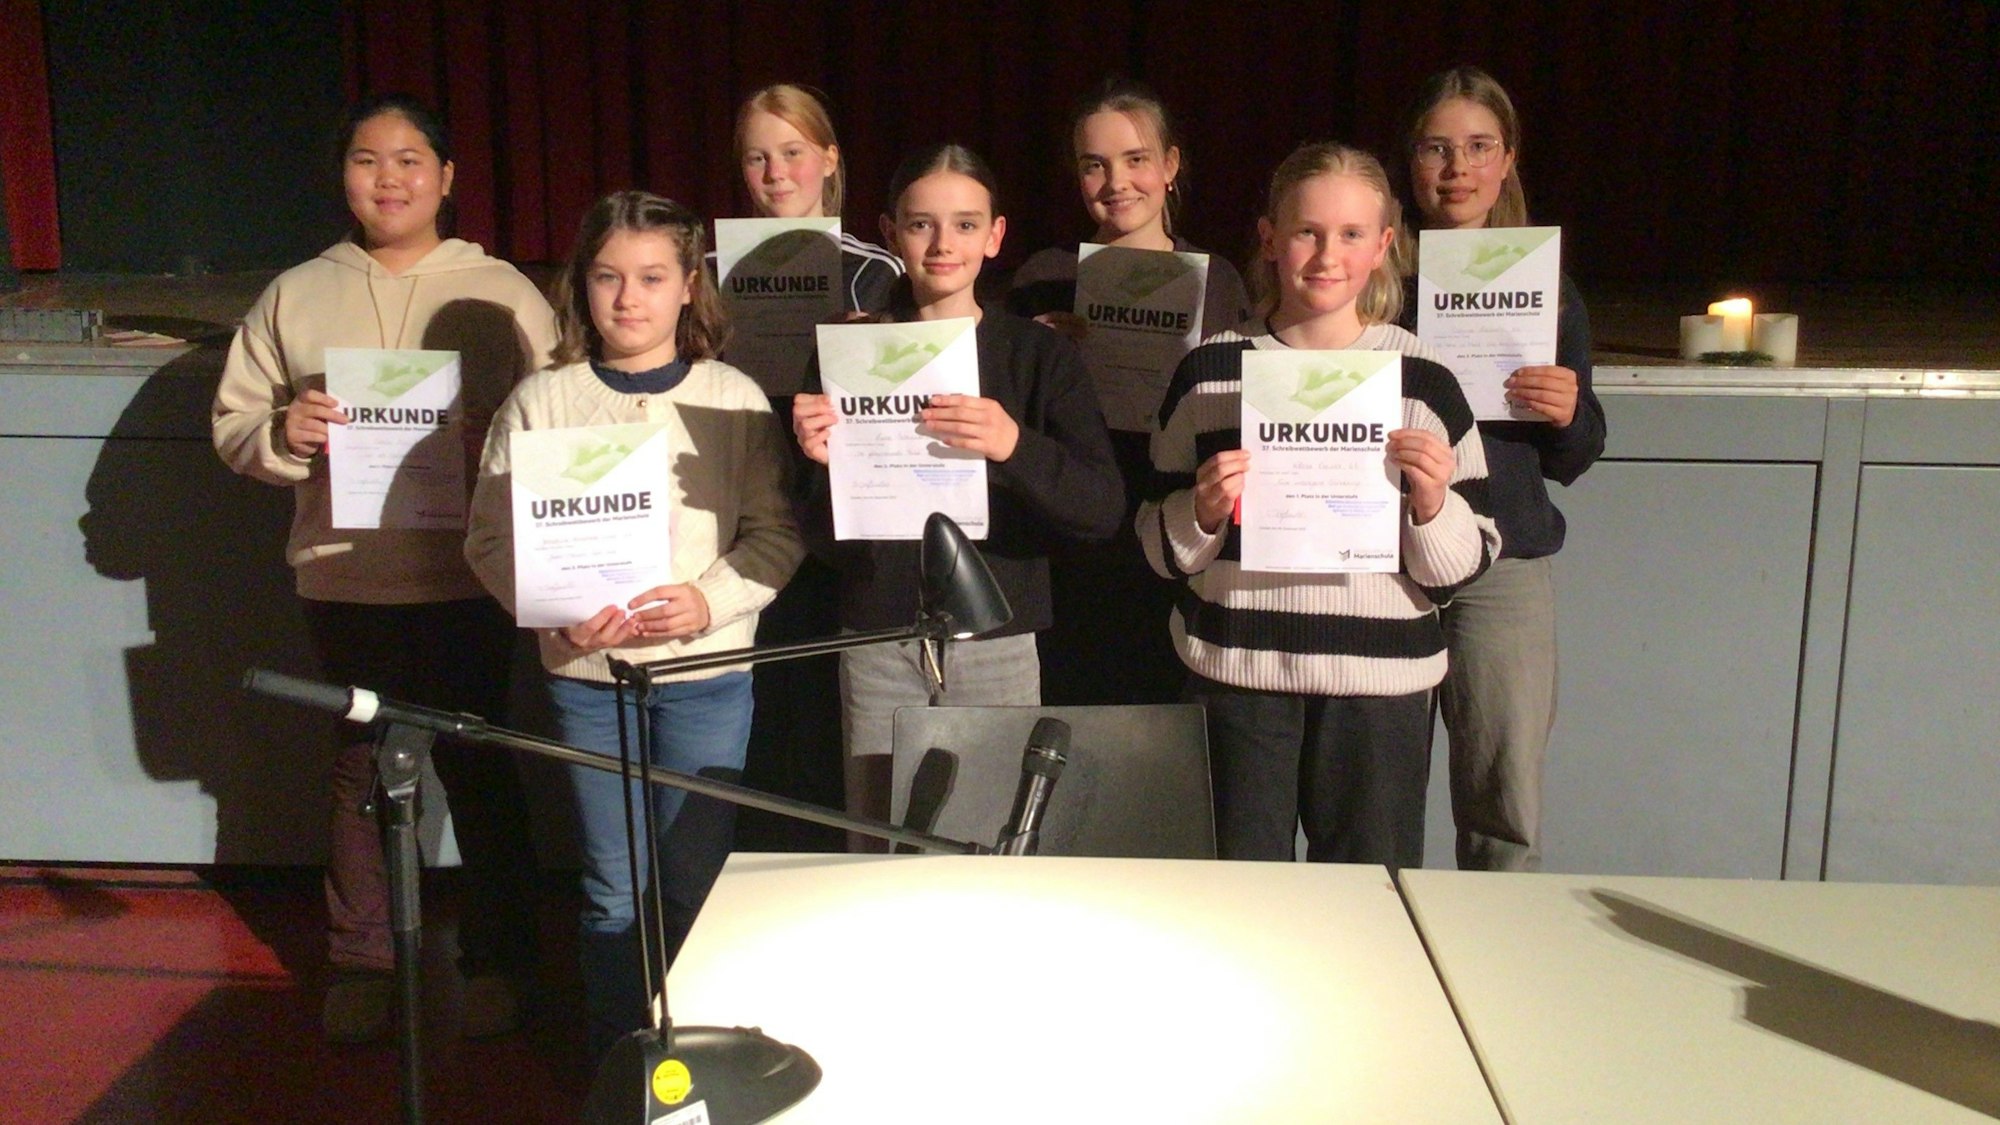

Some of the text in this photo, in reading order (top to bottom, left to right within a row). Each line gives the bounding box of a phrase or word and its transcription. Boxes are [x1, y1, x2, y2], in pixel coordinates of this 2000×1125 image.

[732, 275, 830, 294] URKUNDE
[1434, 291, 1543, 310] URKUNDE
[1088, 303, 1188, 330] URKUNDE
[840, 394, 962, 416] URKUN
[1259, 423, 1384, 443] URKUNDE
[531, 491, 652, 519] URKUNDE
